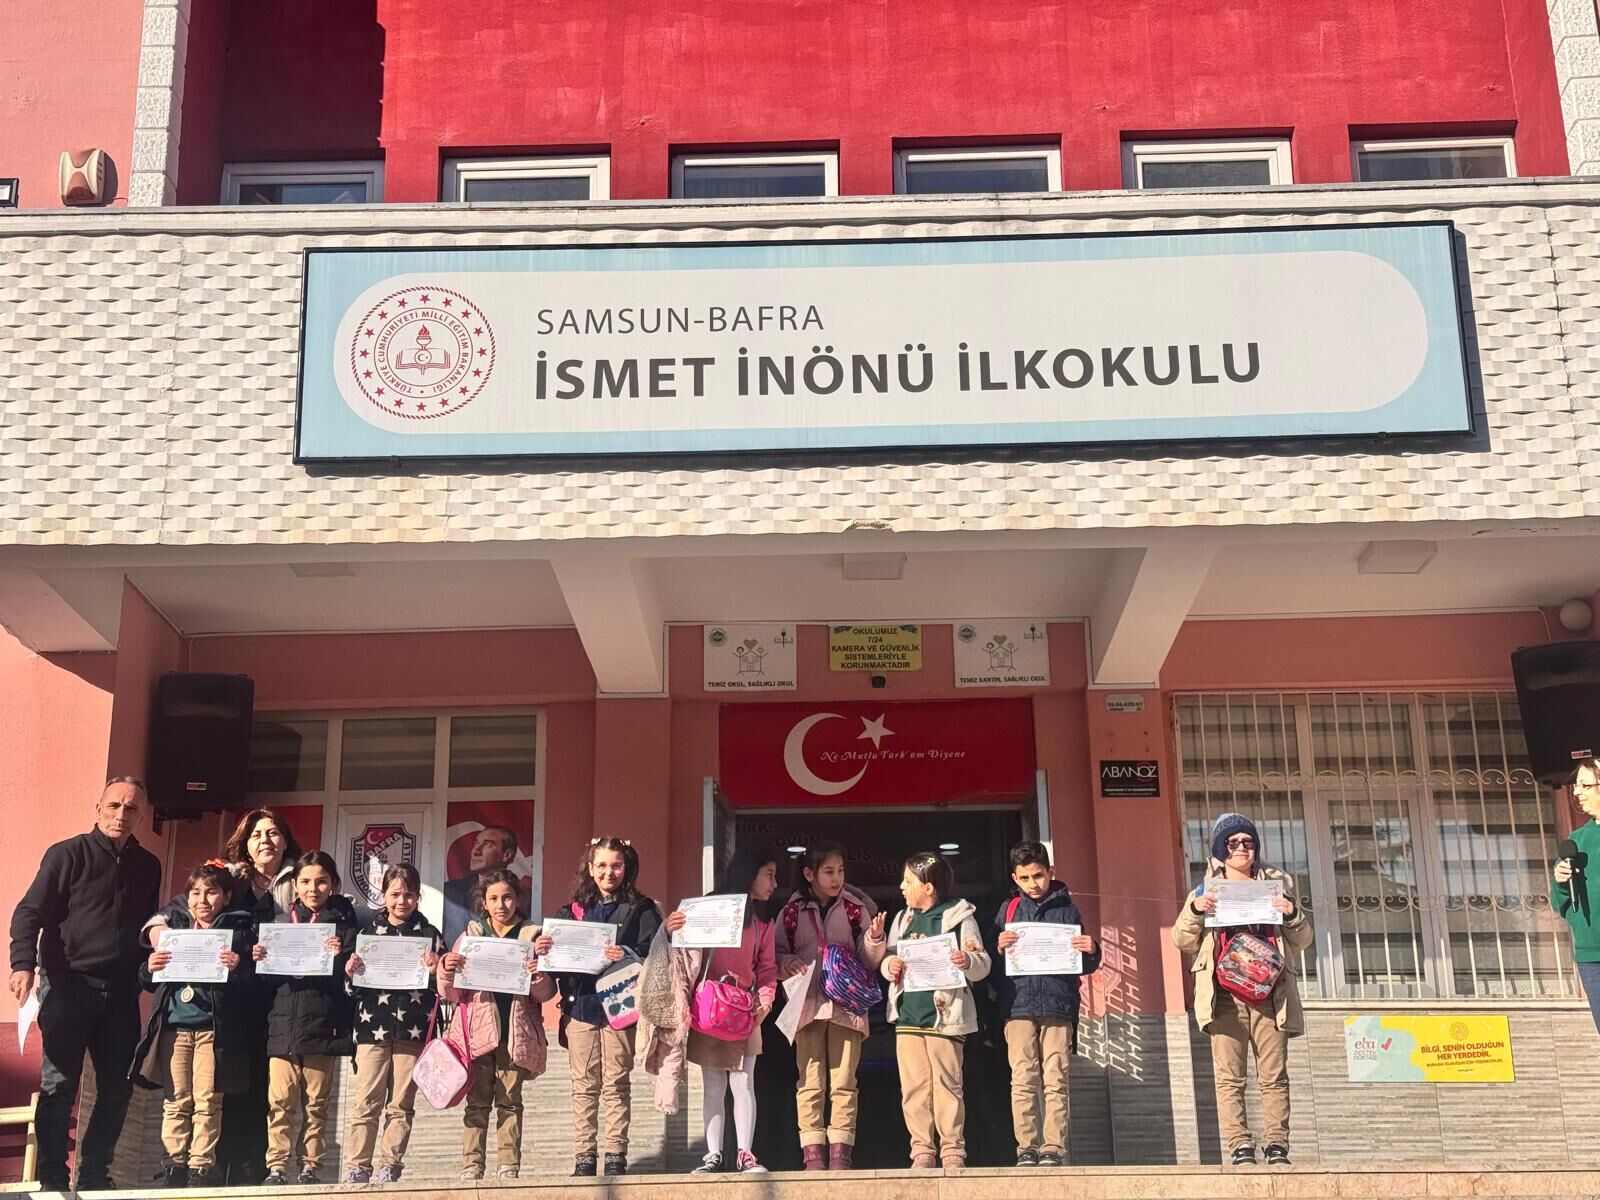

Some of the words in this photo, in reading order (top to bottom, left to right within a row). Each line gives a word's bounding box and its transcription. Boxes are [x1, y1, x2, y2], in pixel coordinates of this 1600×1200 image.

[421, 310, 448, 322] MİLLİ
[536, 304, 824, 335] SAMSUN-BAFRA
[378, 310, 418, 363] CUMHURİYETİ
[448, 320, 469, 350] EĞİTİM
[433, 352, 468, 393] BAKANLIĞI
[535, 350, 715, 400] İSMET
[737, 343, 933, 396] İNÖNÜ
[958, 341, 1261, 391] İLKOKULU
[380, 364, 412, 393] TÜRKİYE
[853, 627, 897, 635] OKULUMUZ
[867, 644, 878, 652] VE
[879, 643, 920, 652] GÜVENLİK
[844, 652, 907, 661] SİSTEMLERİYLE
[841, 661, 911, 669] KORUNMAKTADIR
[820, 751, 838, 762] Ne
[840, 751, 877, 760] Mutlu
[927, 749, 966, 761] Diyene
[1102, 765, 1158, 778] ABANOZ
[366, 832, 402, 859] BAFRA
[1421, 1044, 1442, 1054] BİLGİ,
[1443, 1042, 1465, 1052] SENİN
[1466, 1040, 1504, 1050] OLDUĞUN
[1437, 1053, 1452, 1061] HER
[1453, 1050, 1491, 1060] YERDEDİR.
